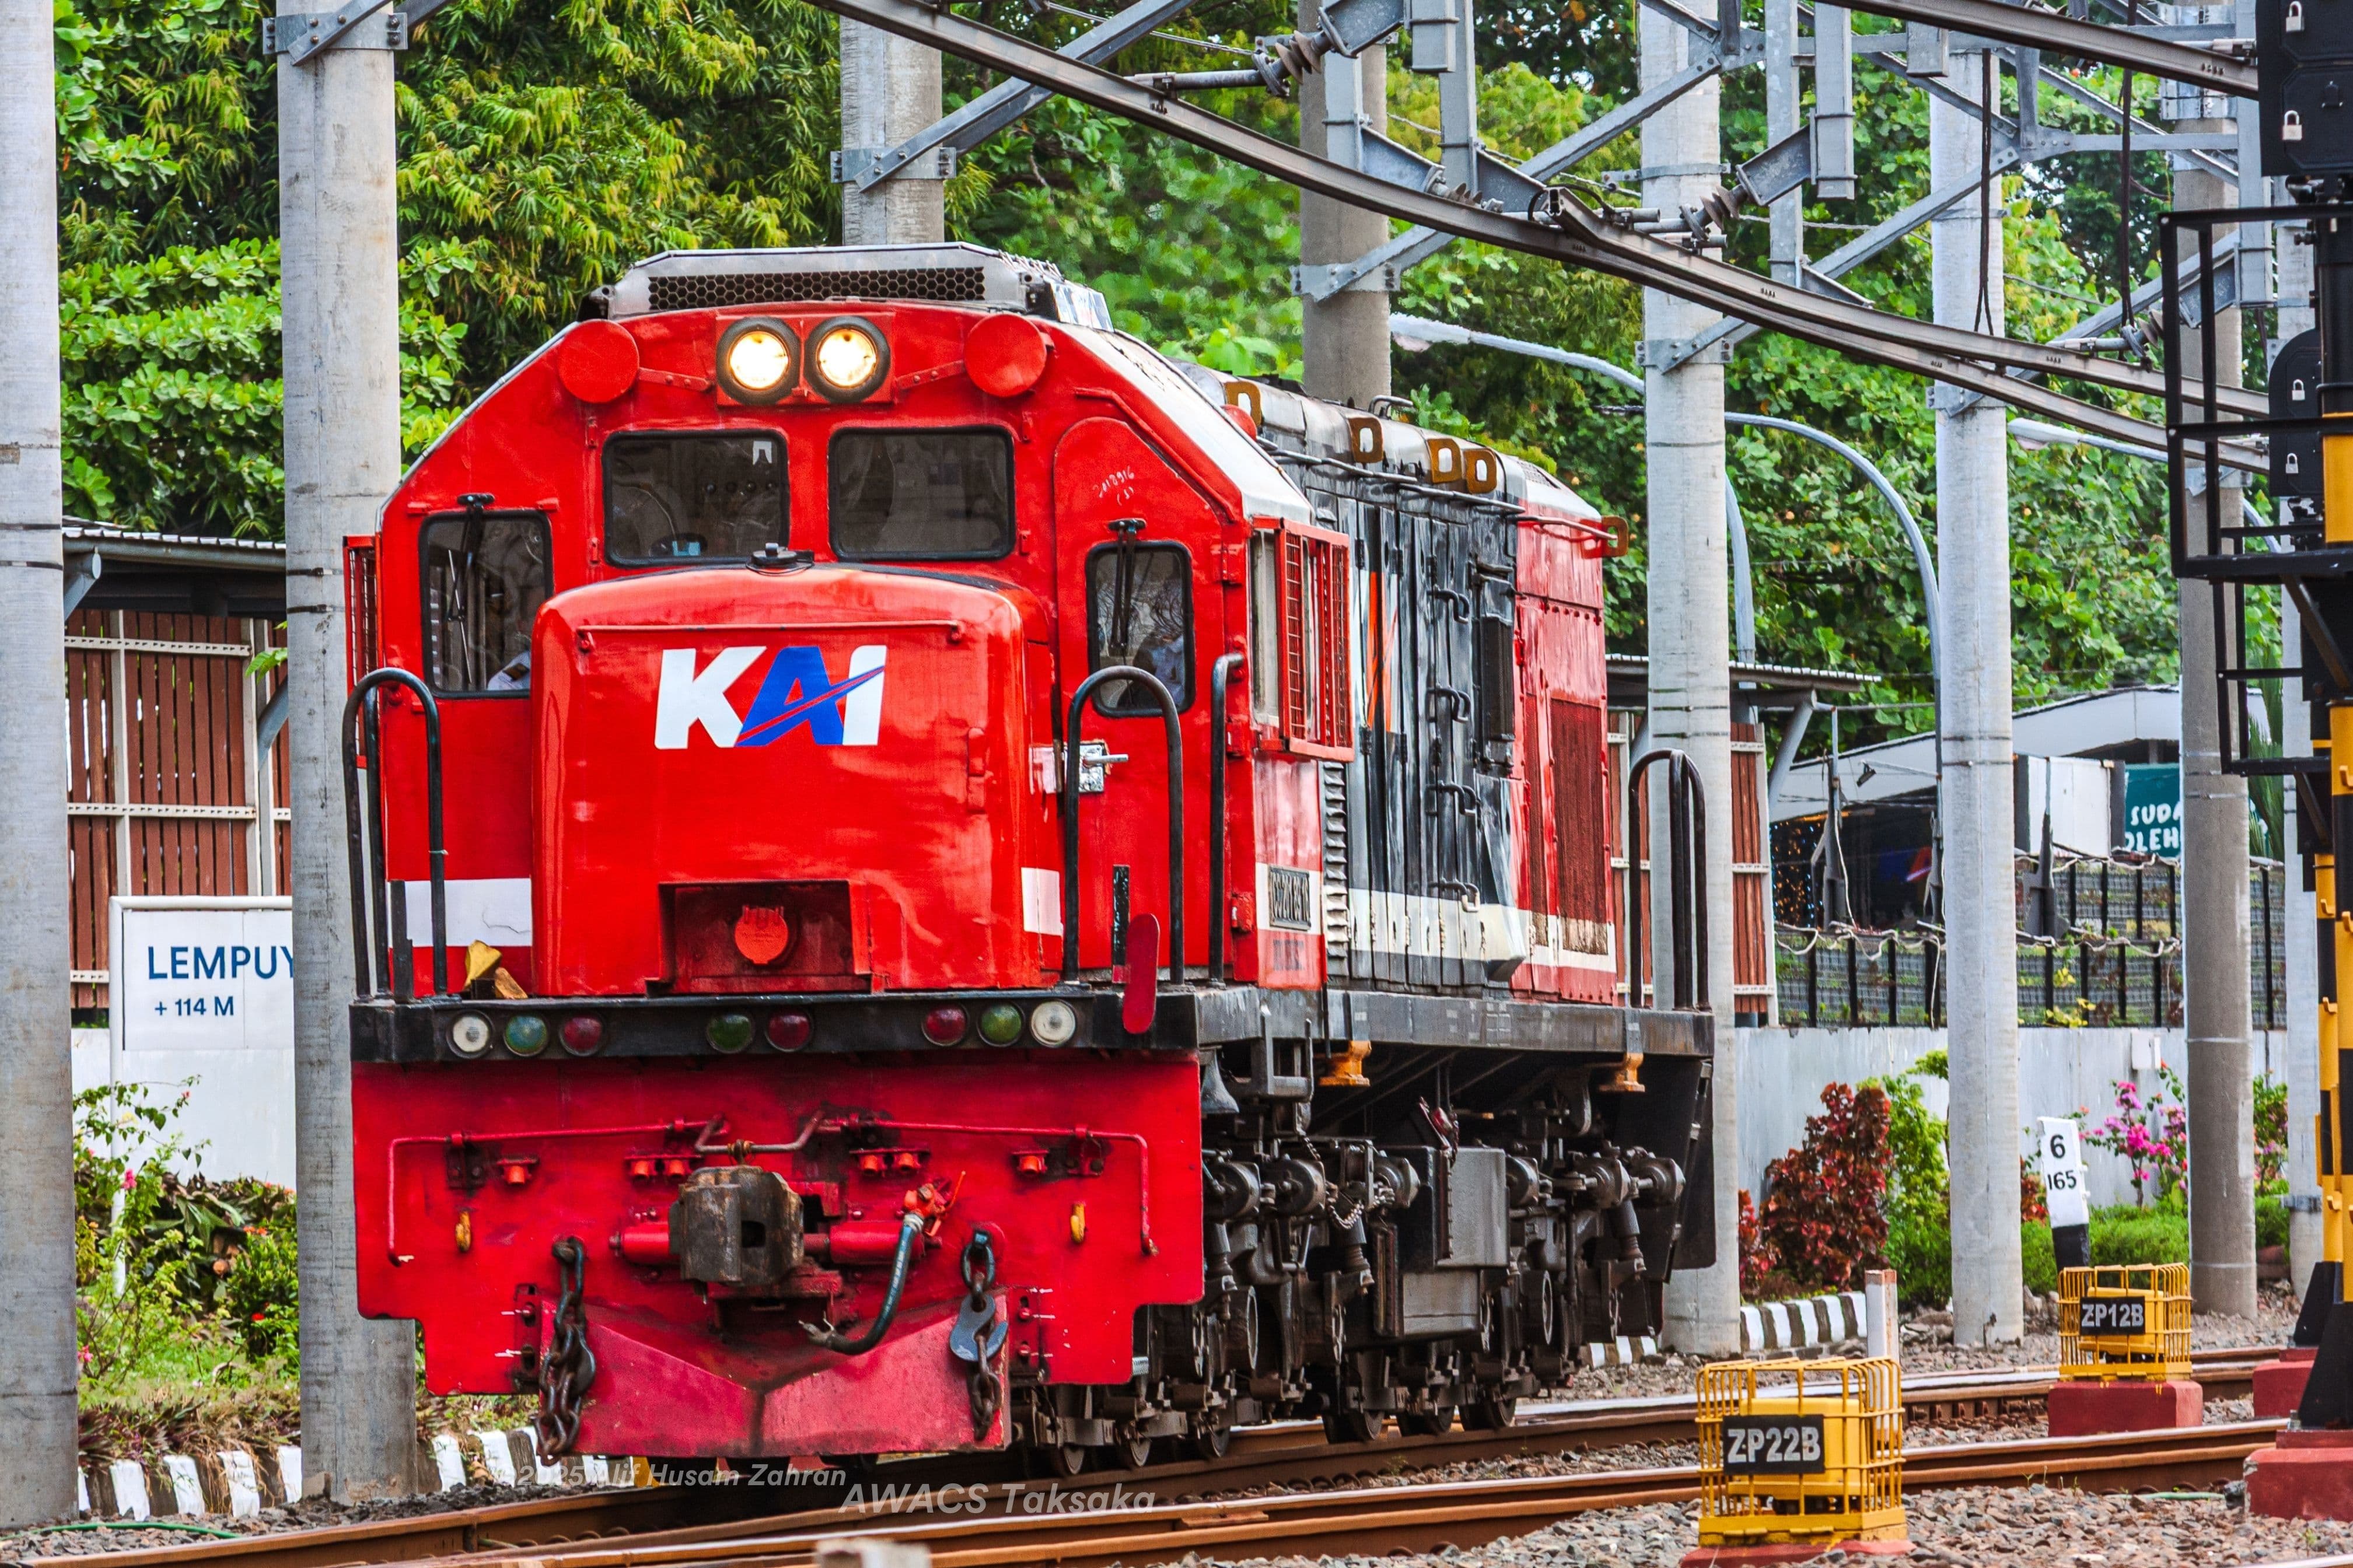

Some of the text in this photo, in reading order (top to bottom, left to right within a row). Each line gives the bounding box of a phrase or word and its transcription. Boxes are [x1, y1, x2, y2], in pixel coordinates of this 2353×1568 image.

[654, 645, 887, 750] KAI
[148, 946, 293, 979] LEMPUY
[215, 996, 233, 1016] M
[2050, 1135, 2065, 1158] 6
[2048, 1170, 2076, 1190] 165
[2081, 1304, 2144, 1328] ZP12B
[1727, 1427, 1821, 1464] ZP22B
